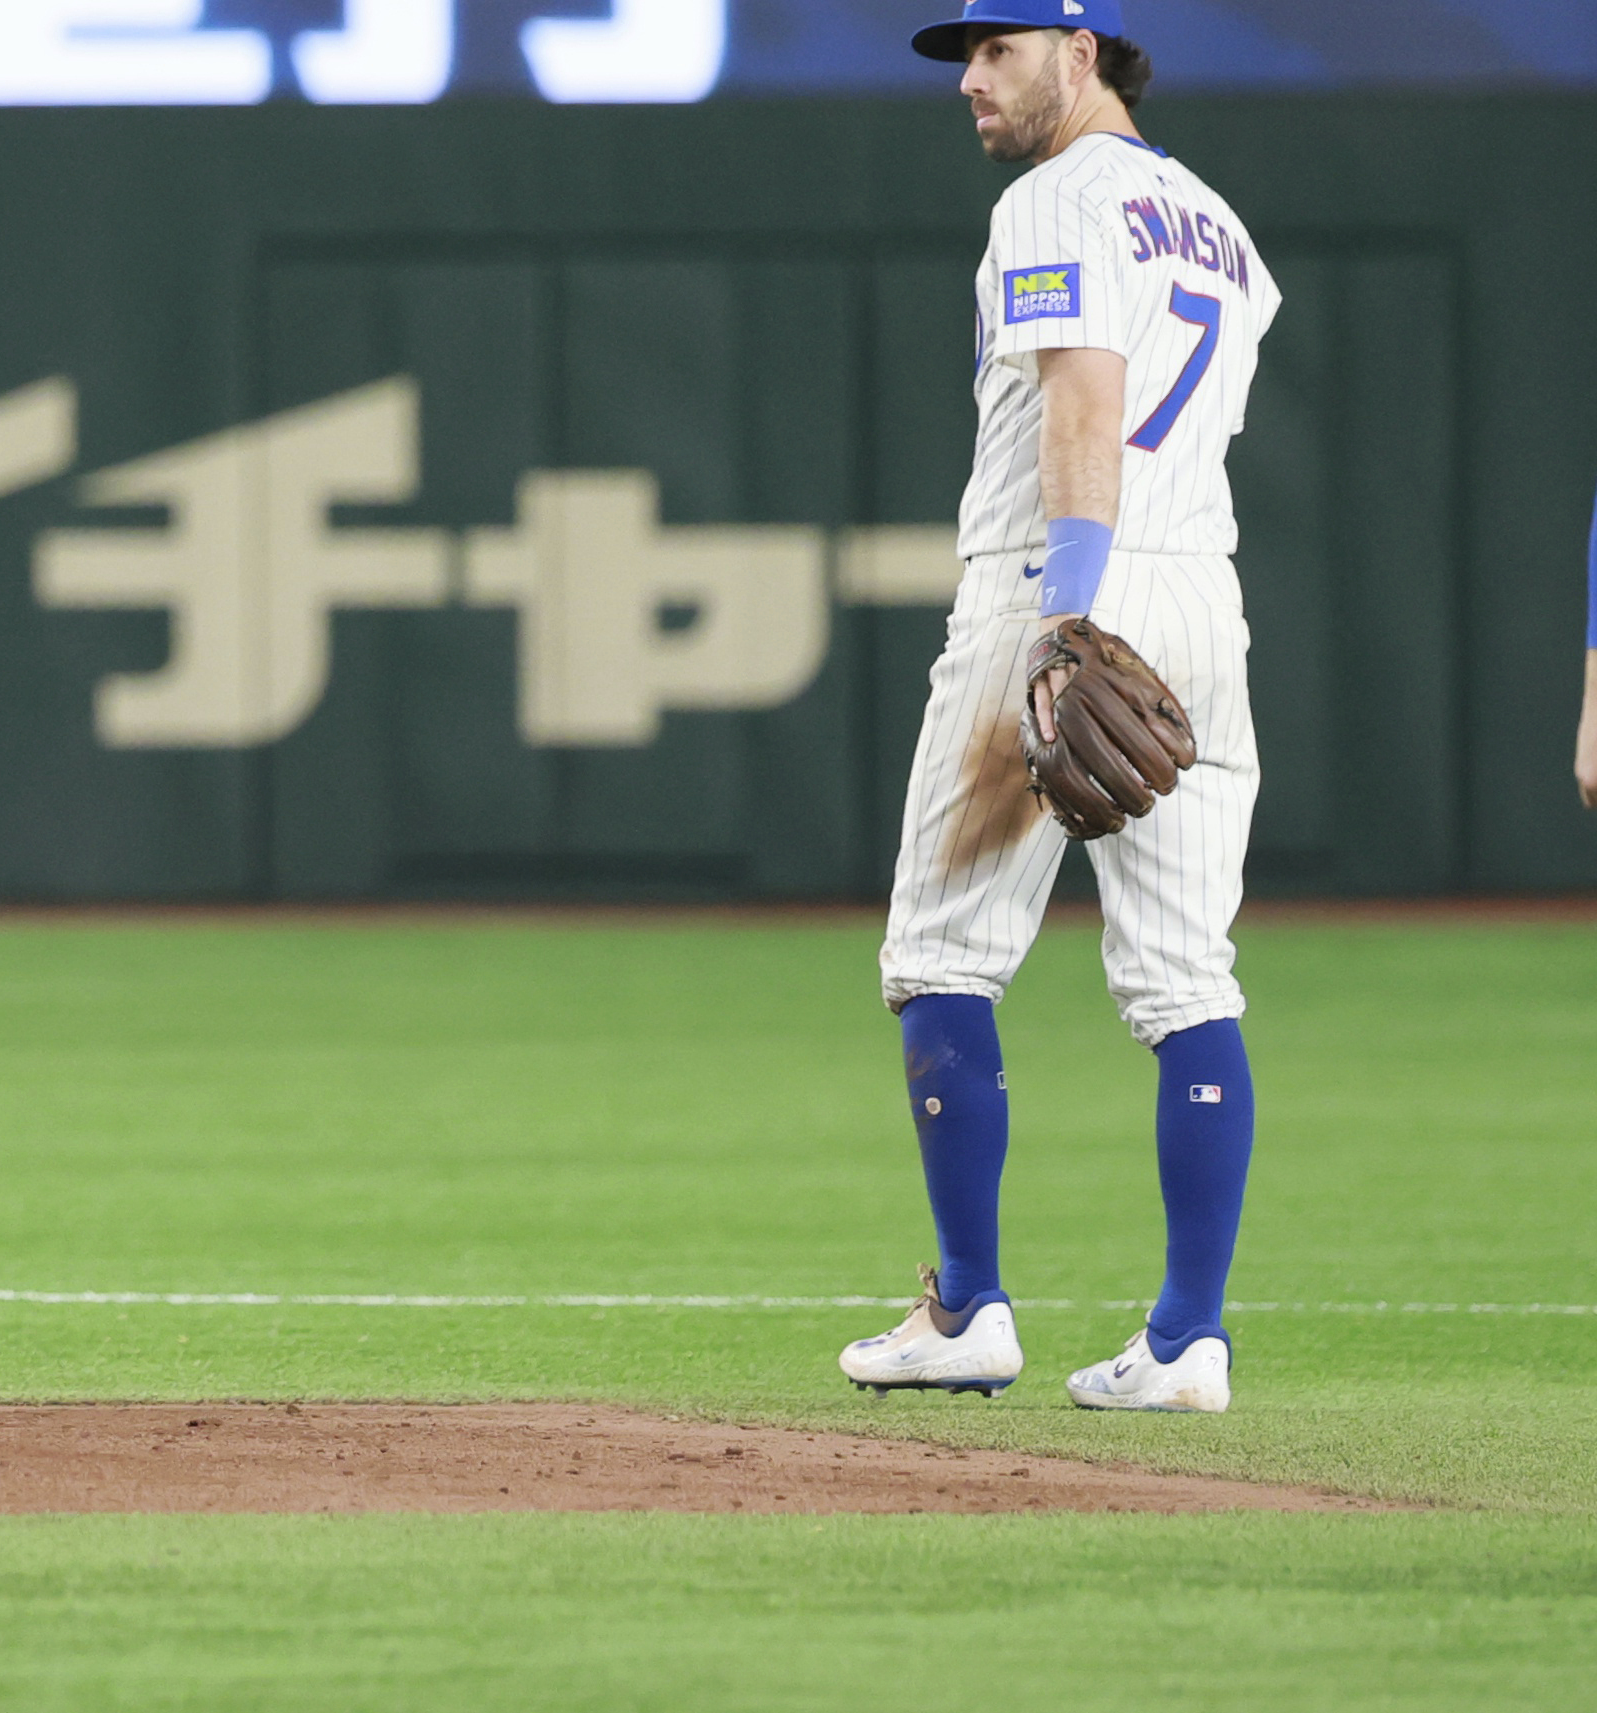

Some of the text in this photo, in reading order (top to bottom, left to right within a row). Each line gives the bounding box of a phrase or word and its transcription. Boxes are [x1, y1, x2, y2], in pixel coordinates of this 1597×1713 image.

[1122, 195, 1251, 301] SWANSON
[1013, 291, 1070, 307] NIPPON
[1013, 301, 1070, 318] EXPRESS
[1126, 279, 1222, 453] 7
[1045, 585, 1058, 605] 7
